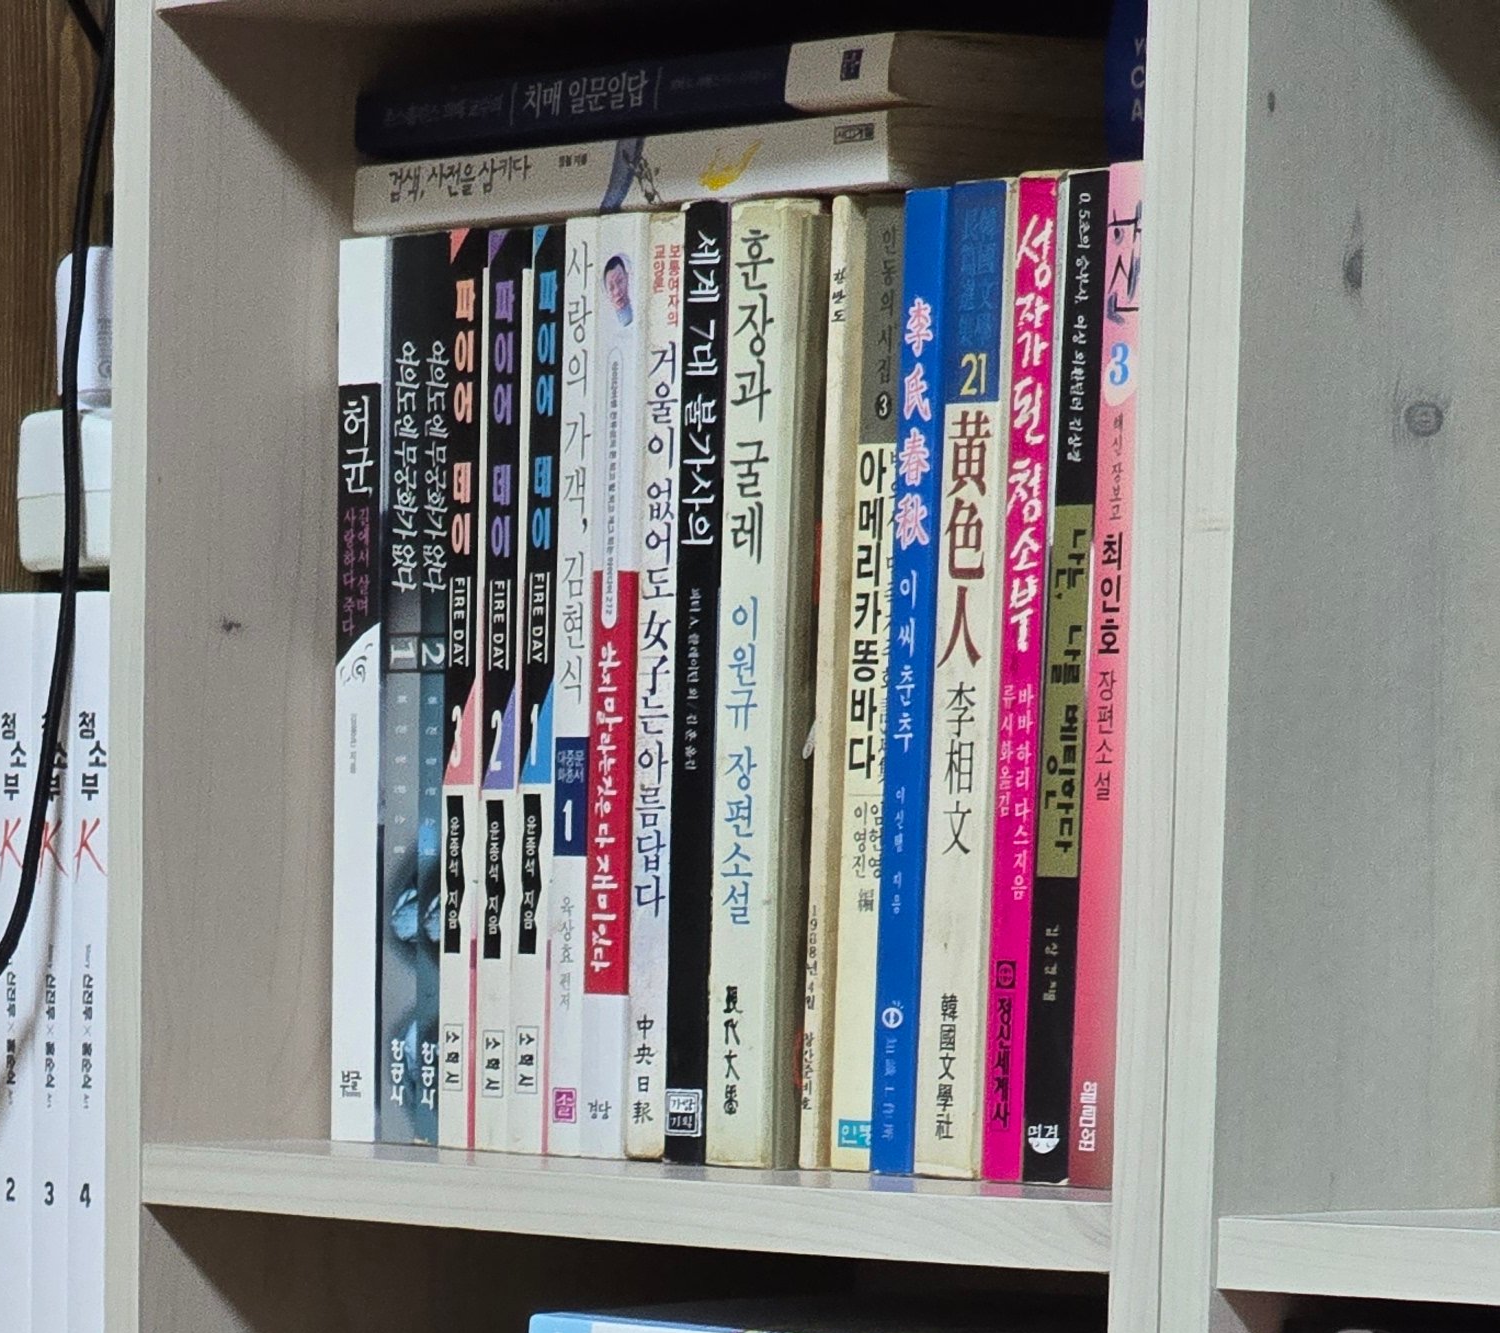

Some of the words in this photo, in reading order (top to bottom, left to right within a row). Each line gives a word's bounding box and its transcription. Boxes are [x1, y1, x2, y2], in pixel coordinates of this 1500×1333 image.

[522, 81, 562, 119] 치매
[568, 70, 649, 114] 일문일답
[428, 161, 474, 198] 사전을
[478, 153, 533, 194] 삼키다
[687, 229, 722, 306] 세계
[831, 267, 847, 324] 한반도
[1014, 214, 1053, 371] 성자가
[566, 240, 593, 398] 사랑의
[685, 320, 718, 376] 7대
[730, 228, 774, 421] 훈장과
[393, 340, 421, 439] 여의도엔
[647, 341, 678, 470] 거울이
[897, 297, 933, 549] 李氏春秋
[960, 354, 987, 396] 21
[1013, 380, 1045, 446] 된
[392, 441, 419, 538] 무궁화가
[681, 391, 717, 546] 불가사의
[729, 440, 770, 564] 굴레
[392, 543, 418, 593] 없다
[644, 478, 675, 600] 없어도
[852, 448, 887, 635] 아메리카
[1007, 460, 1045, 652] 청소부
[1055, 529, 1086, 600] 나는,
[453, 577, 466, 618] FIRE
[492, 580, 506, 623] FIRE
[559, 549, 590, 704] 김현식
[899, 569, 918, 648] 이씨
[1099, 532, 1123, 655] 최인호
[451, 626, 465, 666] DAY
[492, 631, 505, 670] DAY
[638, 610, 673, 735] 女子는
[724, 596, 762, 729] 이원규
[1051, 625, 1081, 686] 나를
[848, 638, 880, 779] 똥바다
[894, 657, 916, 753] 춘추
[1015, 686, 1034, 735] 바바
[1097, 670, 1116, 801] 장편소설
[943, 682, 976, 855] 李相文
[1014, 741, 1032, 792] 하리
[1046, 704, 1078, 853] 베팅한다
[448, 816, 460, 876] 윤종석
[634, 741, 668, 918] 아름답다
[720, 747, 758, 925] 장편소설
[852, 804, 867, 880] 이영진
[1013, 802, 1029, 848] 다스
[591, 856, 618, 972] 재미있다
[632, 1013, 655, 1124] 中央日報
[935, 992, 959, 1140] 韓國文學社
[991, 997, 1011, 1131] 정신세계사
[1079, 1082, 1098, 1152] 열림원
[80, 1183, 91, 1207] 4
